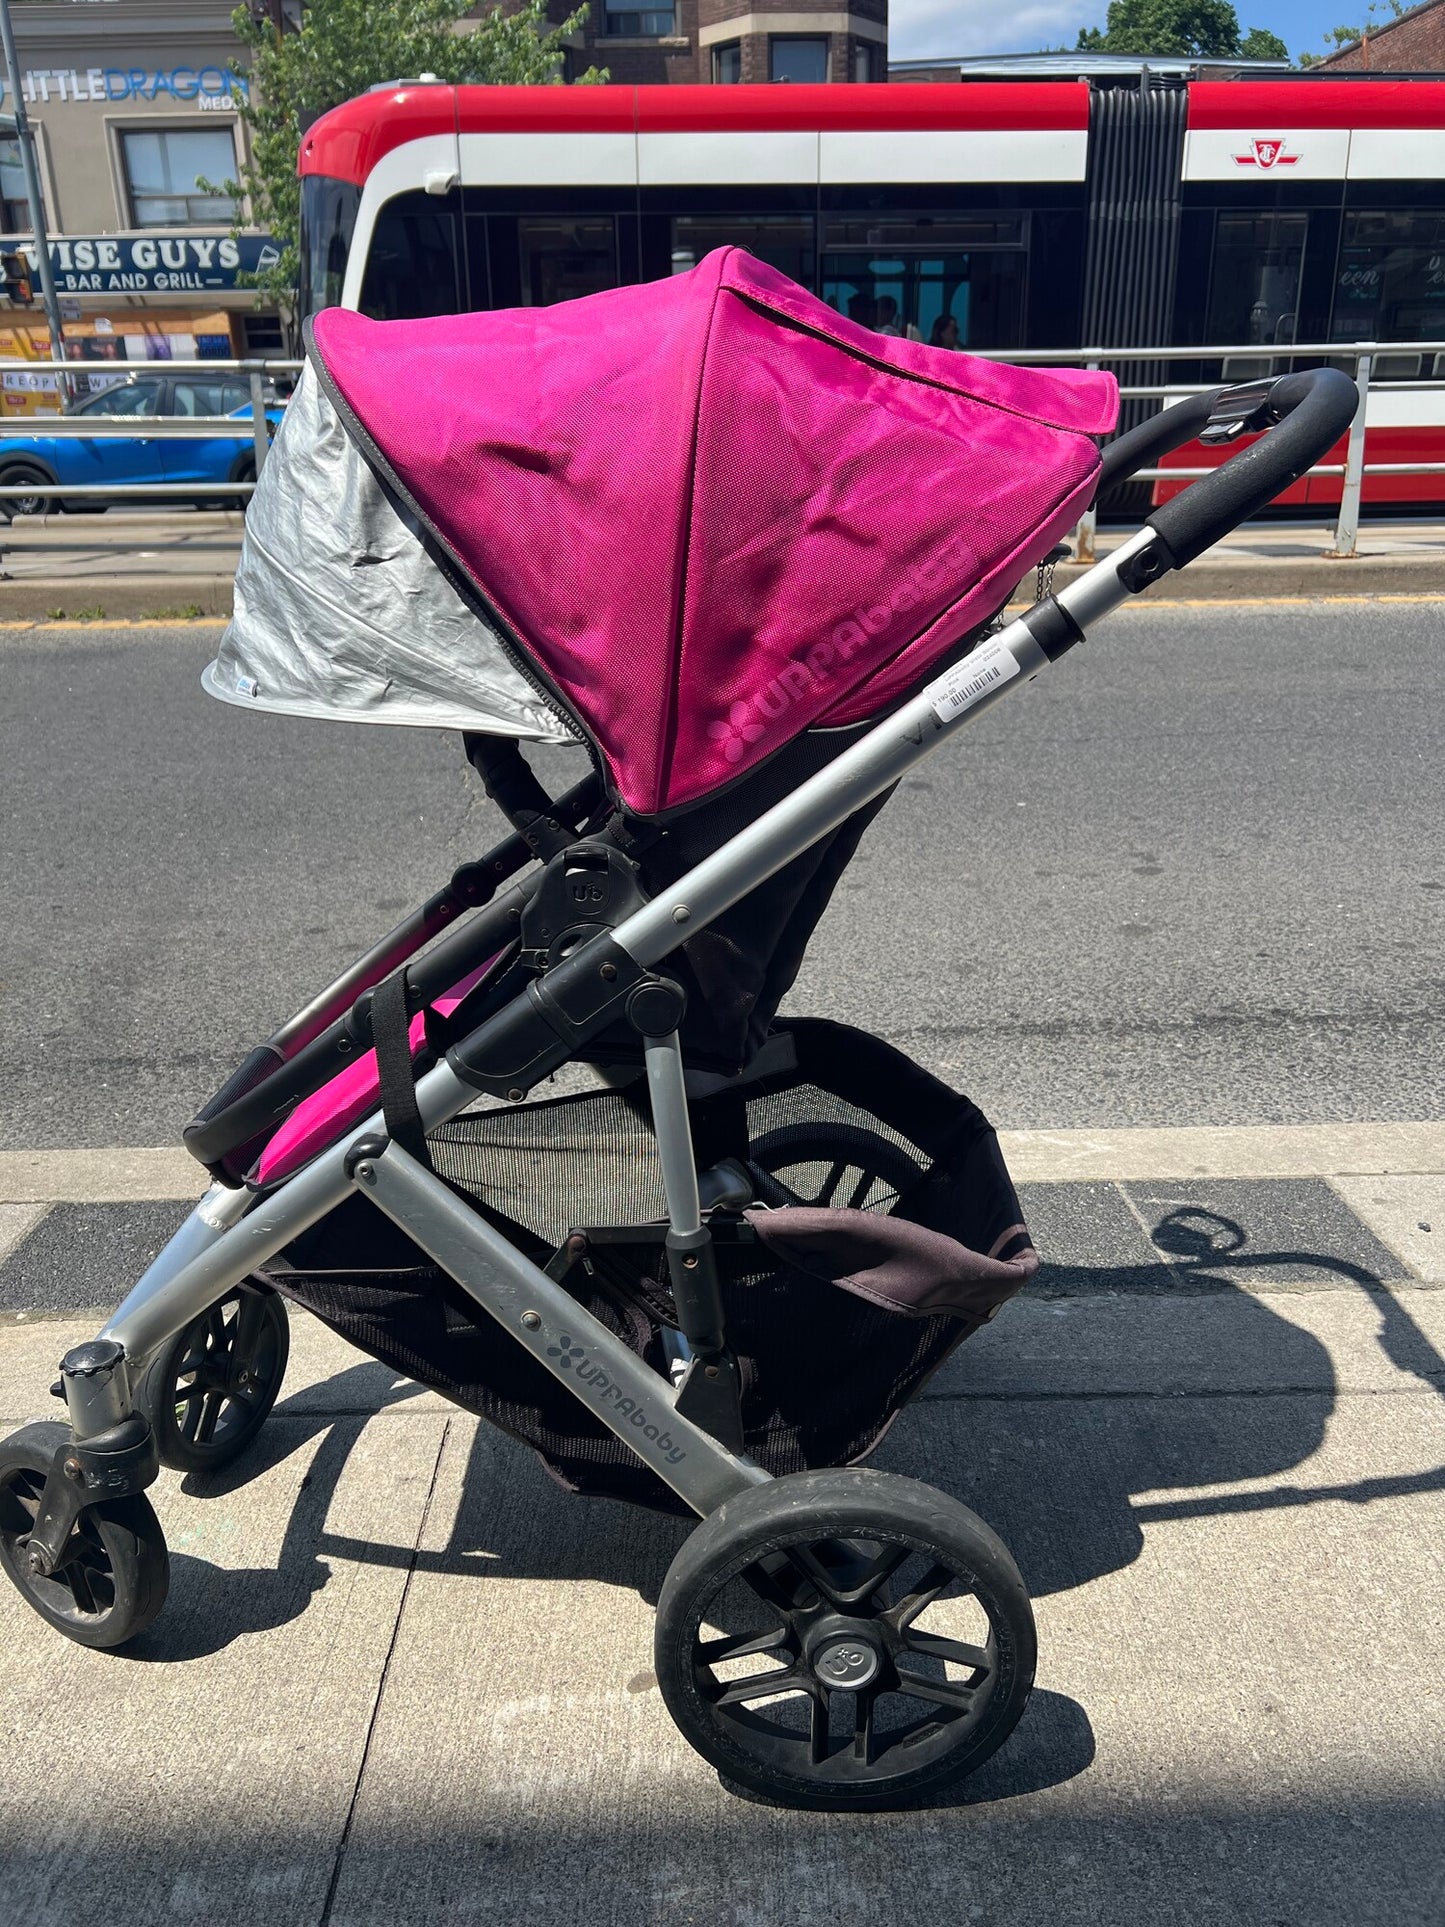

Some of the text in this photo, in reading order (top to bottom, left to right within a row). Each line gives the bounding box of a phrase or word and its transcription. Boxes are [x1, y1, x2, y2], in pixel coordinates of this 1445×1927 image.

[23, 66, 249, 101] ITTLEDRAGON
[131, 239, 241, 270] GUYS
[65, 271, 205, 291] BAR AND GRILL
[754, 537, 977, 719] UPPAbaby
[576, 1359, 687, 1465] UPPAbaby
